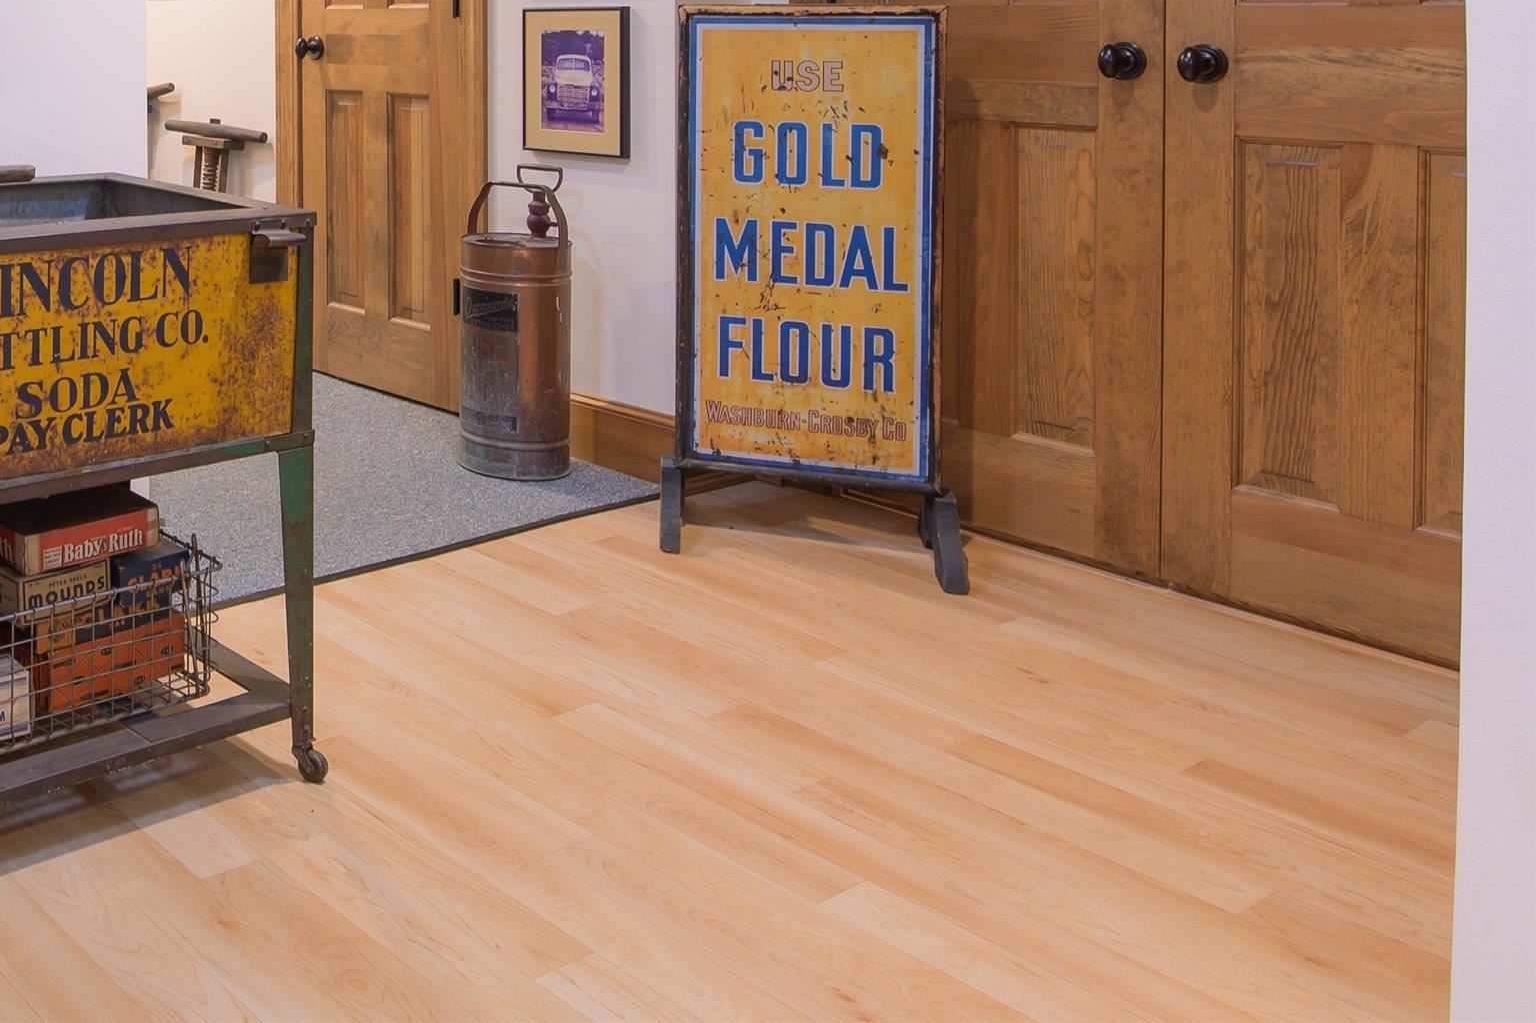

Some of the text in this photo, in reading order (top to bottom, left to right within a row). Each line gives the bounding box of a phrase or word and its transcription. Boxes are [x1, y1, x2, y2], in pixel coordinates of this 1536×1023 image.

[771, 59, 844, 93] USE
[730, 119, 885, 190] GOLD
[713, 216, 911, 294] MEDAL
[155, 309, 210, 349] CO.
[717, 314, 897, 394] FLOUR
[15, 367, 140, 420] SODA
[62, 398, 175, 446] CLERK
[64, 539, 103, 563] Baby
[108, 528, 144, 553] Ruth
